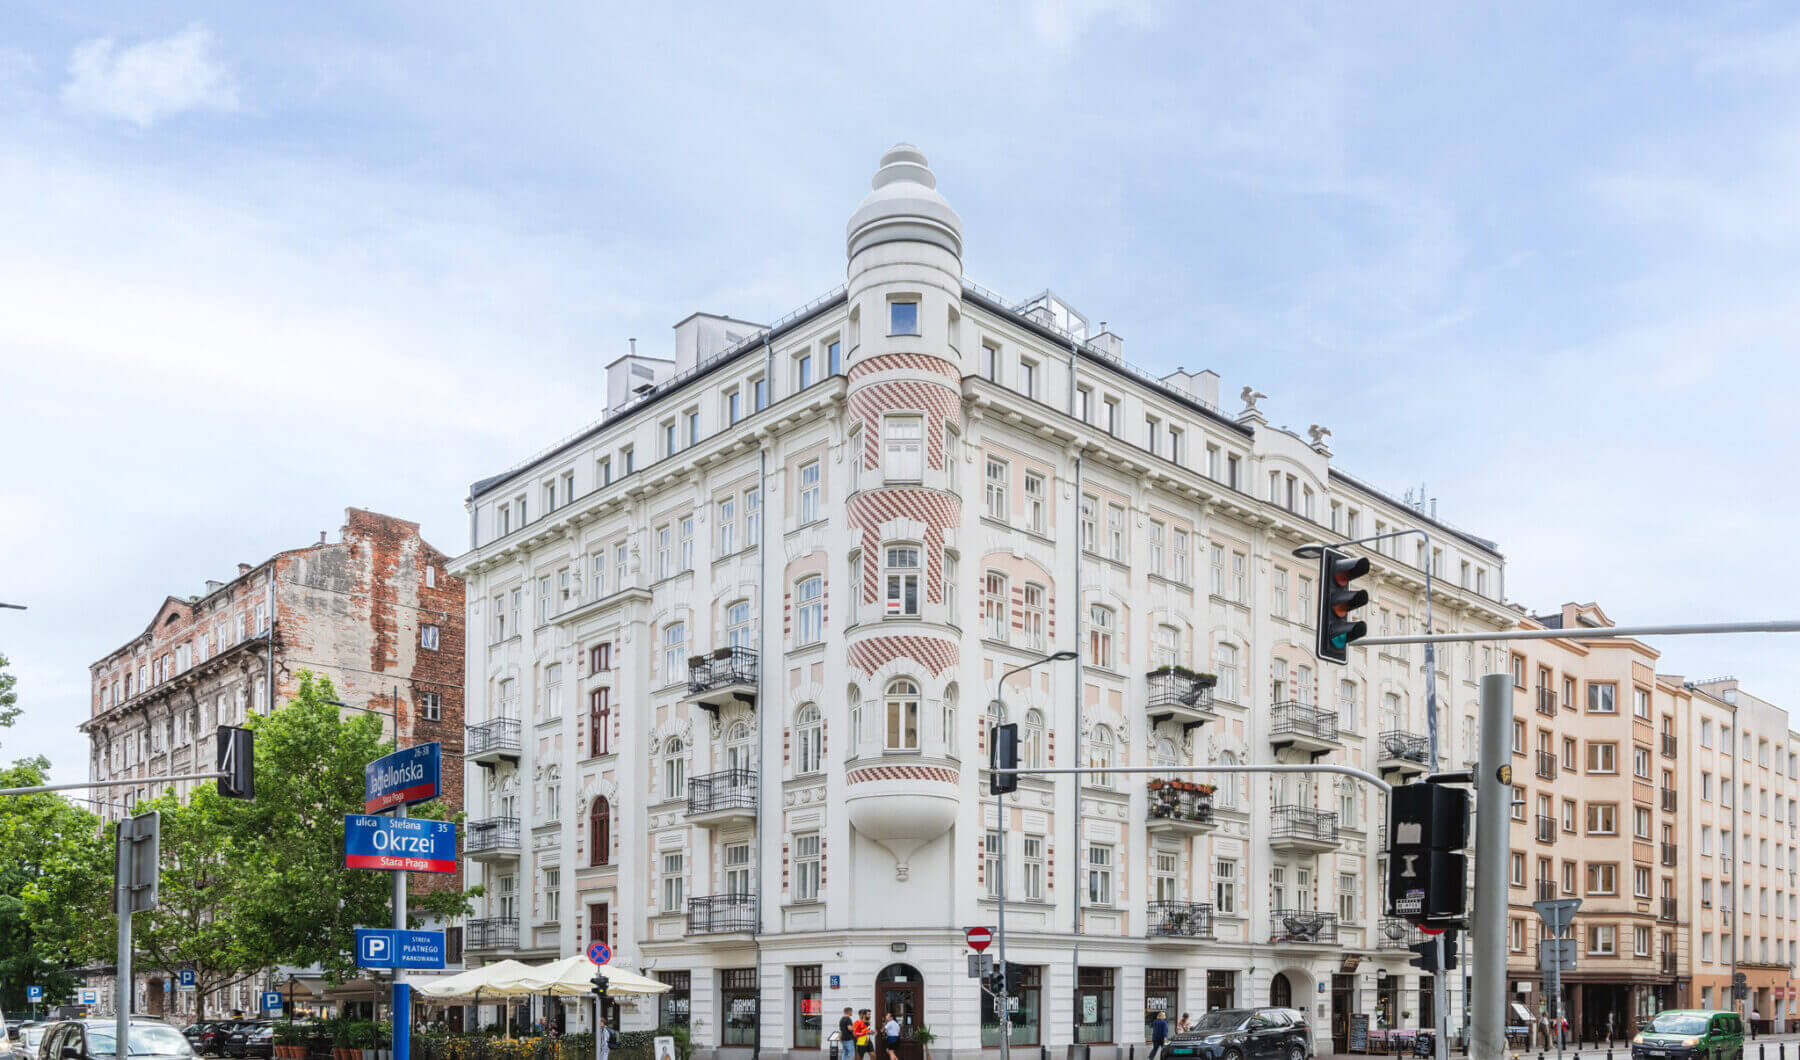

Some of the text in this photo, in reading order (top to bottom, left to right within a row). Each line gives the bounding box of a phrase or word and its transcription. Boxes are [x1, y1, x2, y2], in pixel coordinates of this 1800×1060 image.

[355, 818, 448, 833] ulica Stefana 35
[372, 829, 435, 854] Okrzei
[380, 856, 429, 870] Stara Praga
[369, 939, 385, 957] P
[403, 945, 438, 953] PŁATNEGO
[183, 972, 192, 984] P
[31, 987, 39, 996] P
[266, 994, 279, 1008] P
